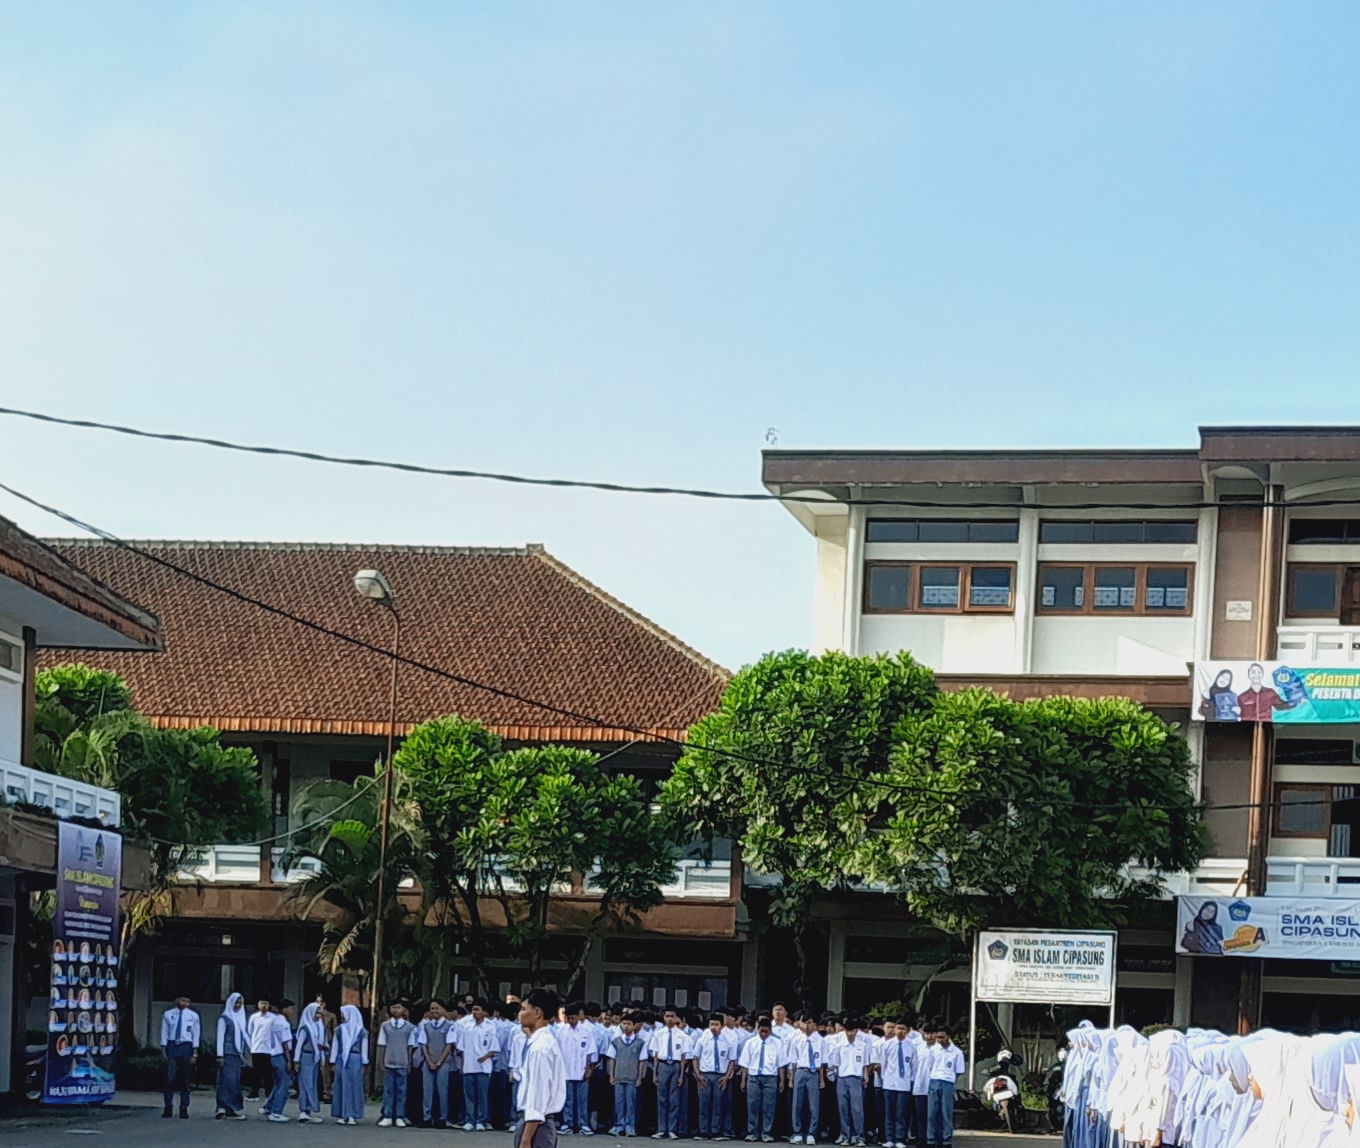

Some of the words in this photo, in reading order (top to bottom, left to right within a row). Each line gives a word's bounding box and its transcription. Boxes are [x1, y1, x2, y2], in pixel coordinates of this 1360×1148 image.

[1304, 673, 1360, 687] Selamat
[1281, 914, 1324, 926] SMA
[1012, 948, 1031, 964] SMA
[1033, 949, 1060, 964] ISLAM
[1063, 949, 1105, 966] CIPASUNG
